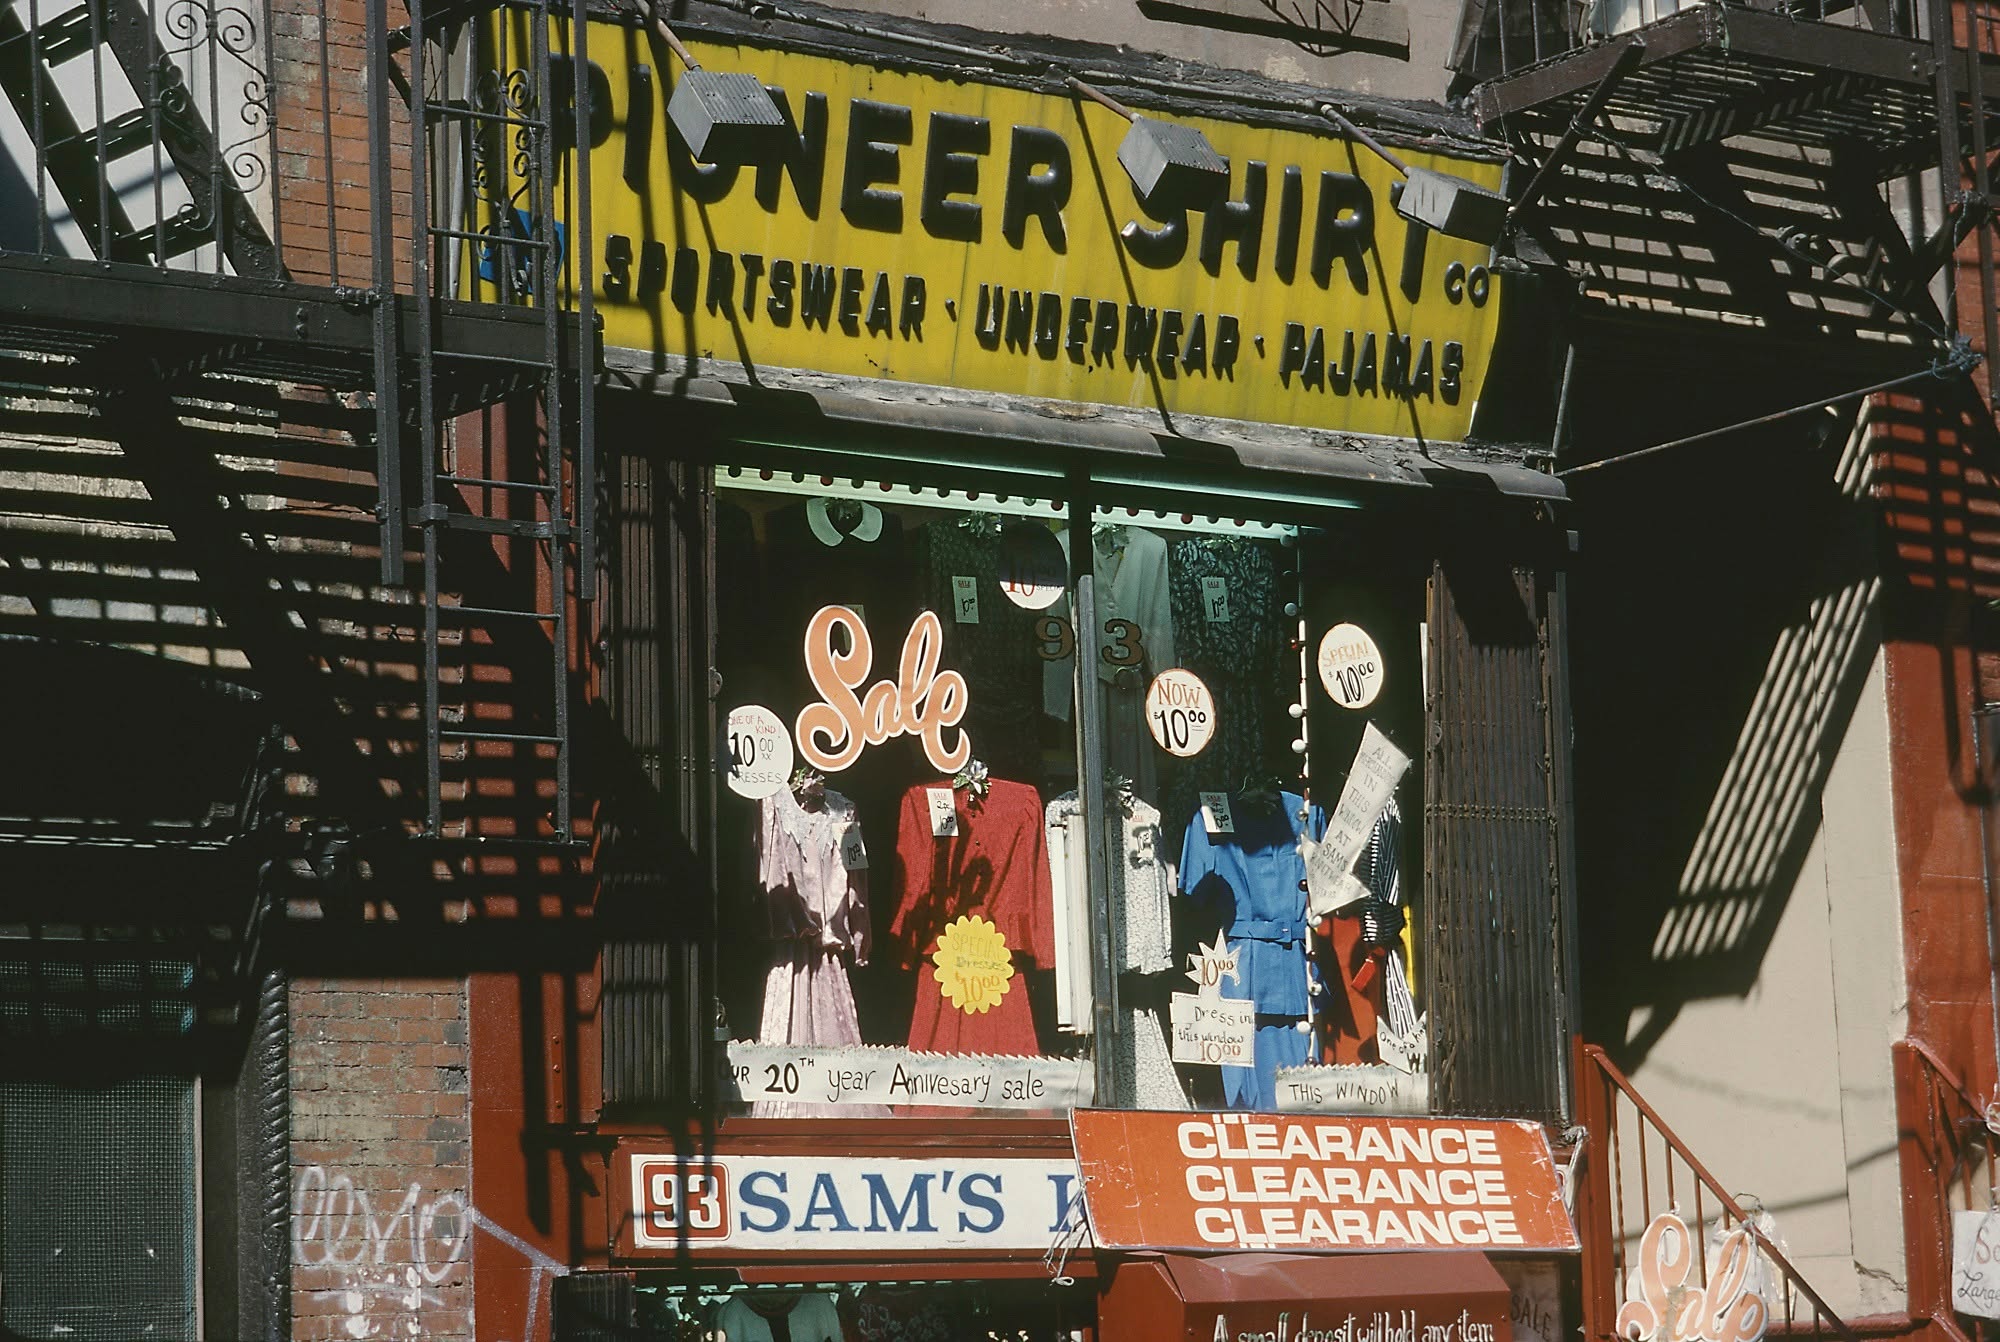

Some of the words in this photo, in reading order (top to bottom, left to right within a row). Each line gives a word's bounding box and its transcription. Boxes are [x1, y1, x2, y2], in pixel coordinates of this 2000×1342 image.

[602, 233, 927, 343] SPORTSWEAR
[975, 282, 1240, 382] UNDERWEAR
[1278, 321, 1464, 406] PAJAMAS
[796, 604, 971, 773] Sale
[1157, 679, 1201, 708] NOW
[1348, 786, 1370, 813] THIS
[1335, 830, 1351, 847] AT
[1178, 1028, 1198, 1042] this
[1202, 1030, 1244, 1044] window
[1195, 1006, 1235, 1026] Dress
[1240, 1011, 1252, 1024] in
[827, 1065, 877, 1102] year
[889, 1062, 991, 1103] Annivesary
[1002, 1069, 1046, 1101] sale
[1288, 1083, 1322, 1104] THIS
[1336, 1077, 1399, 1105] WINDOW
[1177, 1120, 1501, 1165] CLEARANCE
[651, 1173, 721, 1230] 93
[738, 1170, 1003, 1233] SAM'S
[1185, 1165, 1512, 1205] CLEARANCE
[1194, 1206, 1524, 1245] CLEARANCE
[1616, 1213, 1769, 1342] Sale
[1511, 1294, 1552, 1342] SALE
